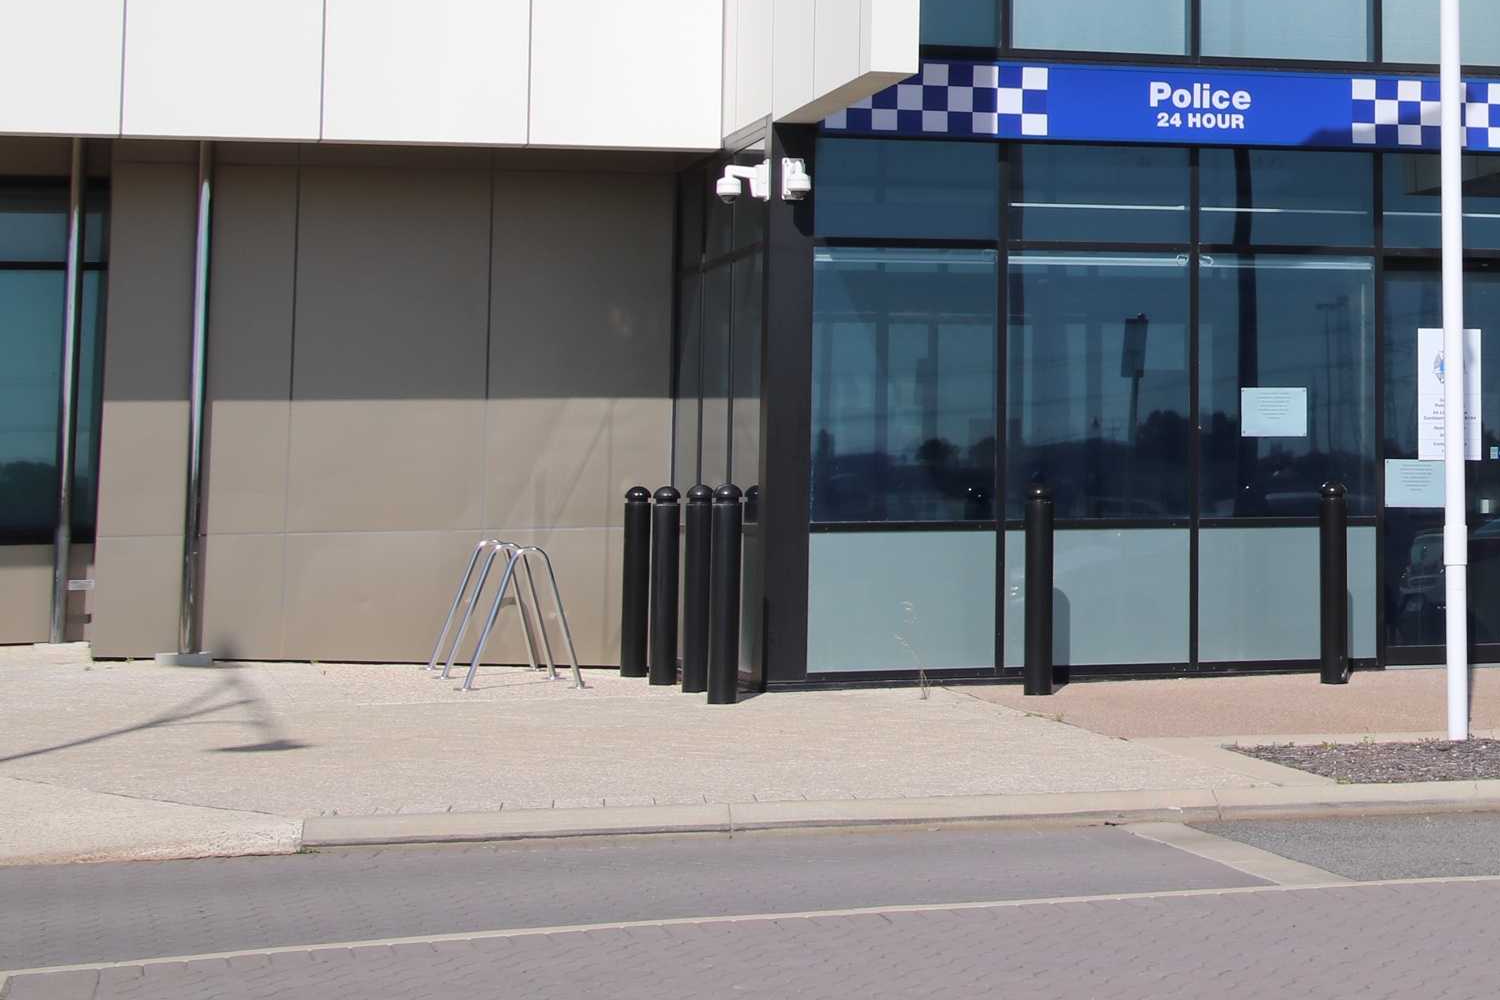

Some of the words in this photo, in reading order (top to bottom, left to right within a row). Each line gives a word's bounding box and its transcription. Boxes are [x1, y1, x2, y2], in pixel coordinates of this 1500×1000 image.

[1149, 81, 1252, 110] Police
[1157, 112, 1182, 127] 24
[1187, 112, 1245, 129] HOUR
